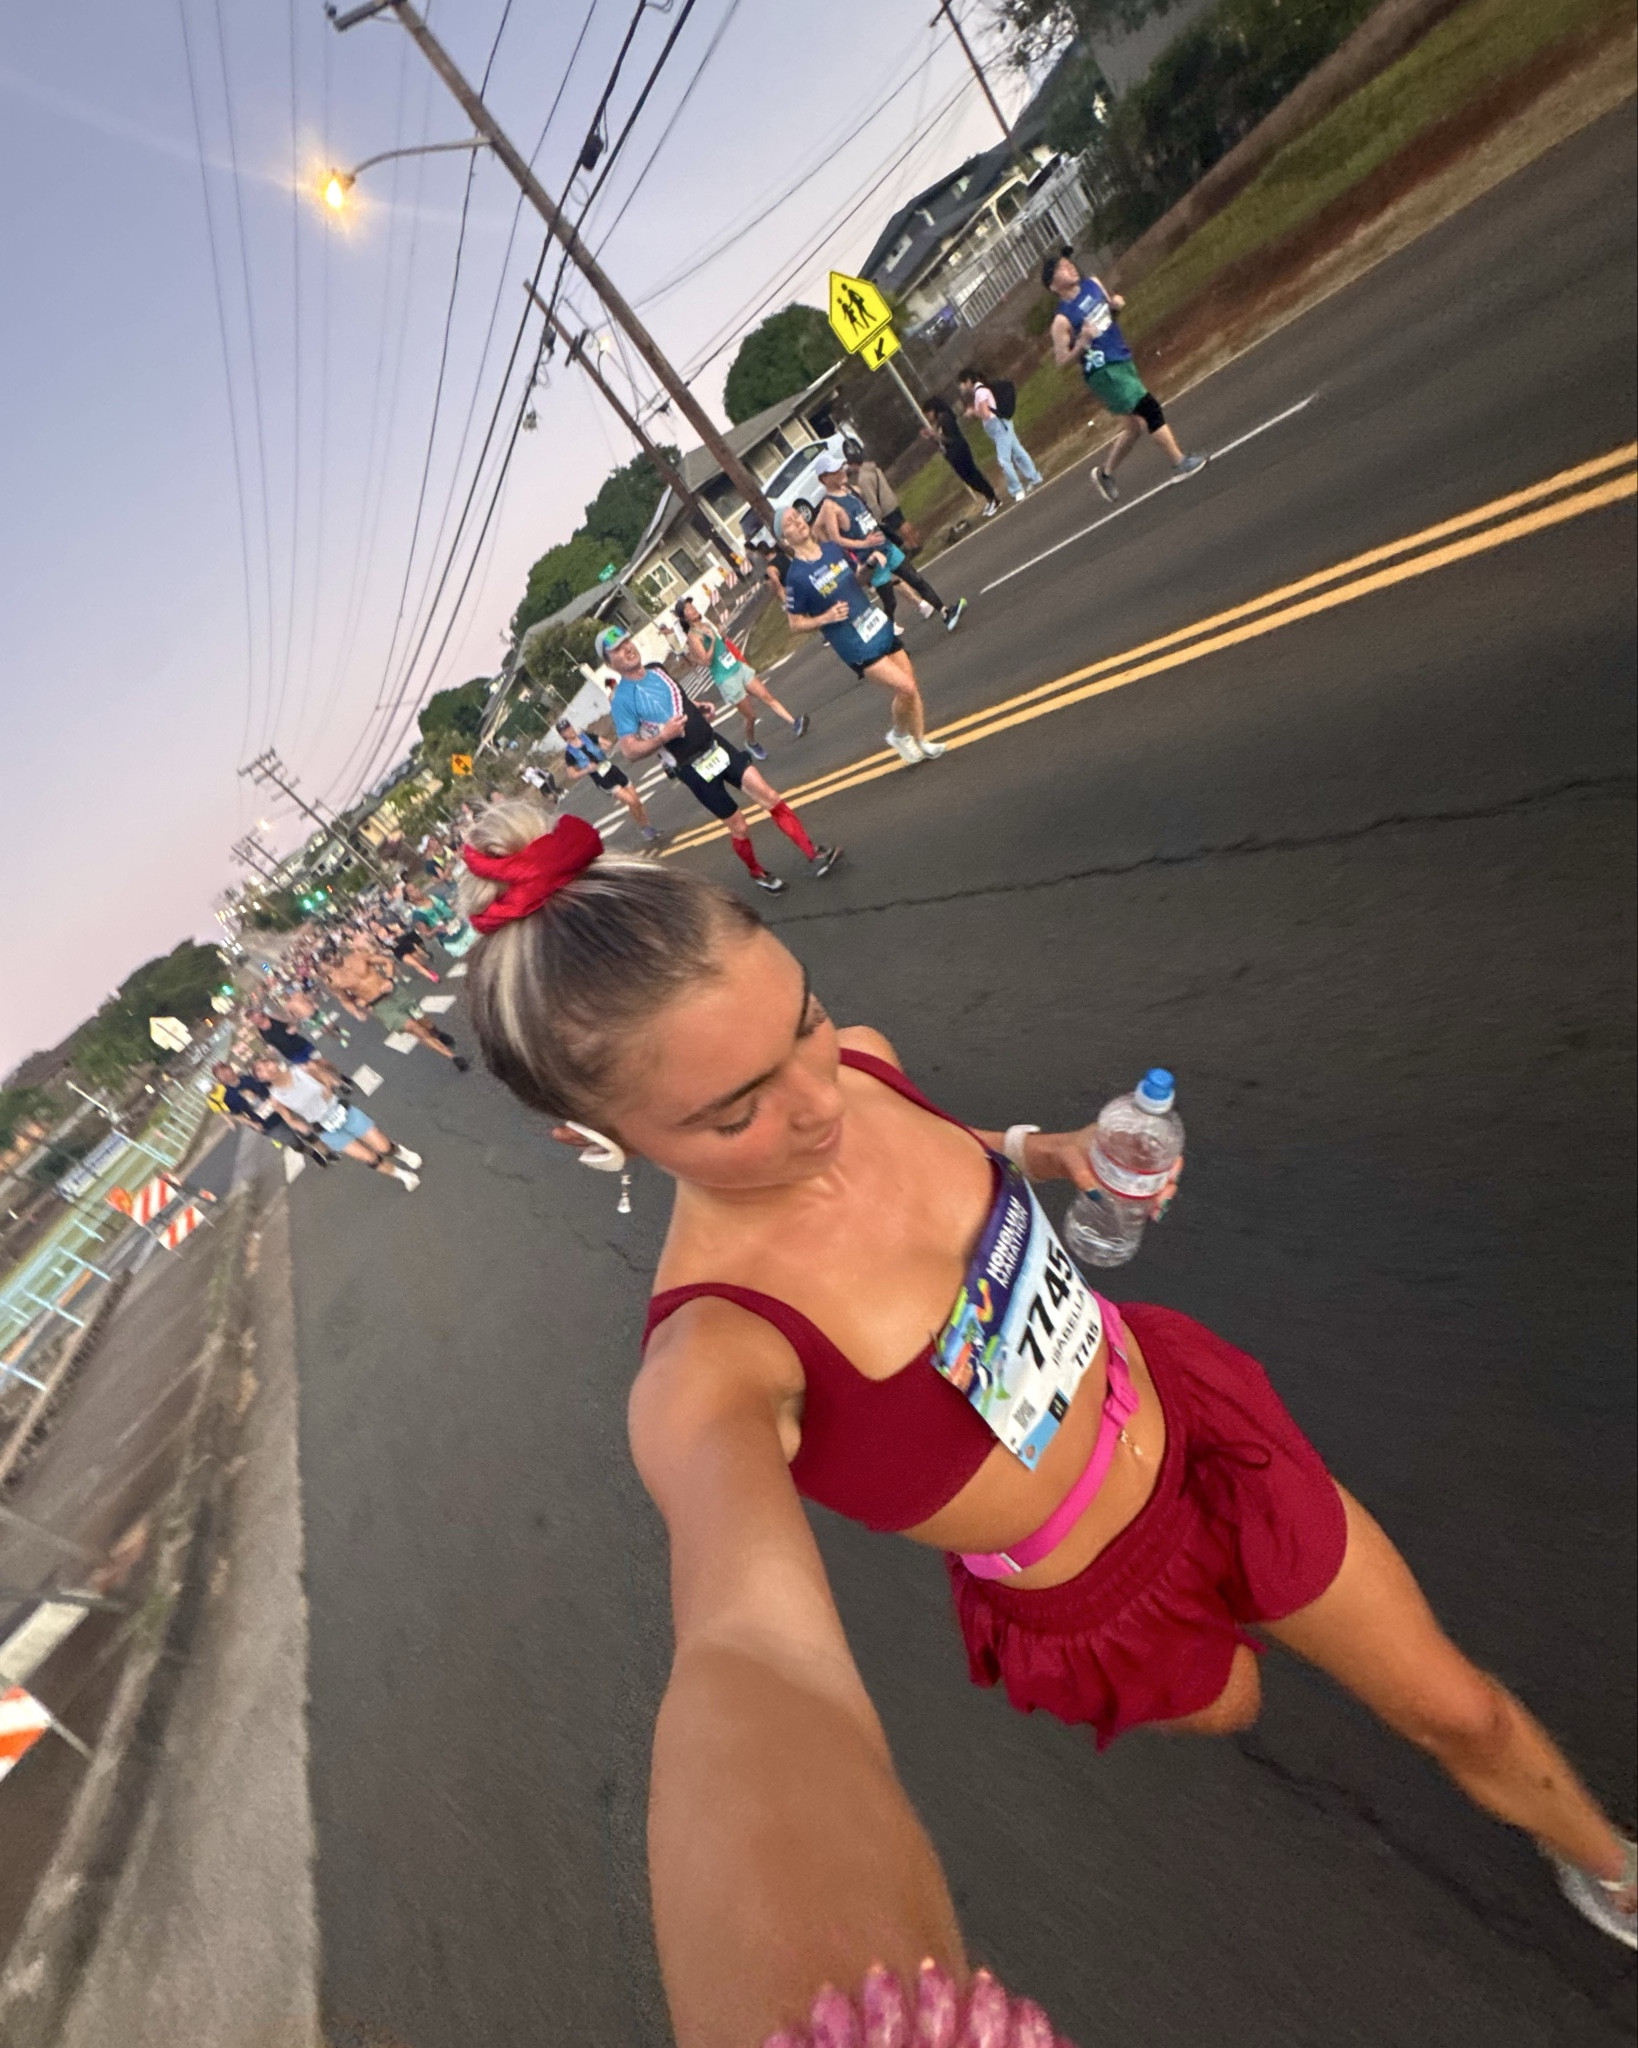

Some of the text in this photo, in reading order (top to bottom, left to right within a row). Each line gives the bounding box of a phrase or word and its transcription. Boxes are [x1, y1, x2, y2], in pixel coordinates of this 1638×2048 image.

[985, 1195, 1022, 1279] HONOLULU
[1017, 1238, 1075, 1371] 7745
[1071, 1321, 1099, 1368] 7745
